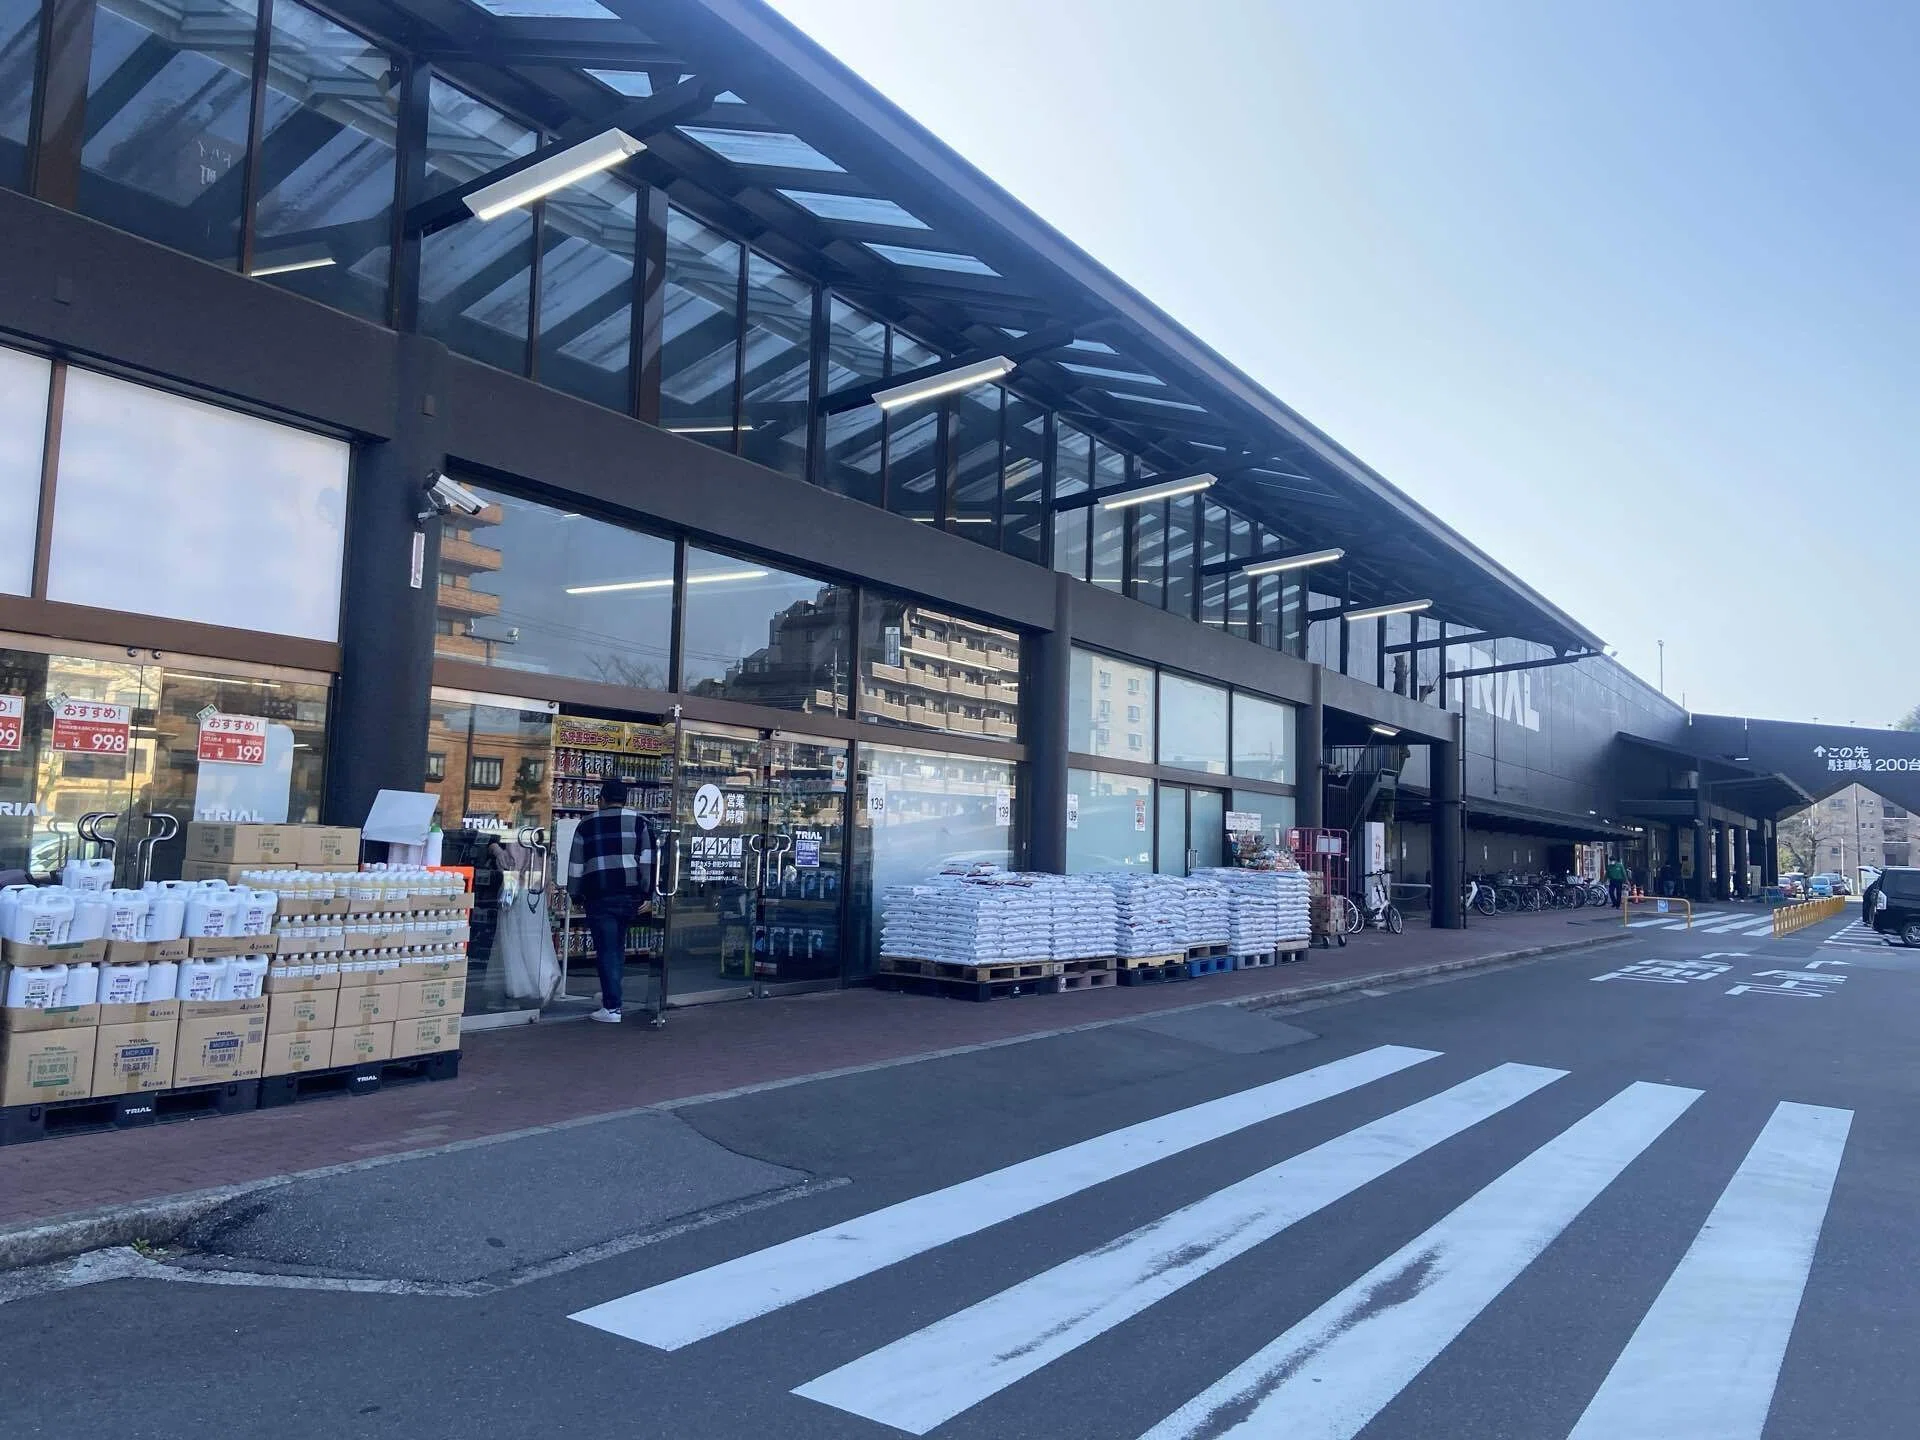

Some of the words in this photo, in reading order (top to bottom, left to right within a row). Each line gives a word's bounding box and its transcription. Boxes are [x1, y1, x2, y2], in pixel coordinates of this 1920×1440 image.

[1446, 643, 1540, 733] TRIAL
[64, 703, 121, 720] おすすめ!
[209, 717, 260, 733] おすすめ!
[92, 733, 125, 751] 998
[236, 745, 263, 761] 199
[1827, 746, 1870, 758] この先
[1827, 759, 1873, 771] 駐車場
[1875, 758, 1920, 771] 200台
[697, 794, 720, 819] 24
[726, 793, 745, 808] 営業
[871, 797, 884, 810] 139
[200, 809, 264, 823] TRIAL
[725, 810, 744, 824] 時間
[998, 806, 1009, 818] 139
[463, 817, 509, 830] TRIAL
[795, 831, 822, 840] TRIAL
[125, 1106, 152, 1115] TRIAL
